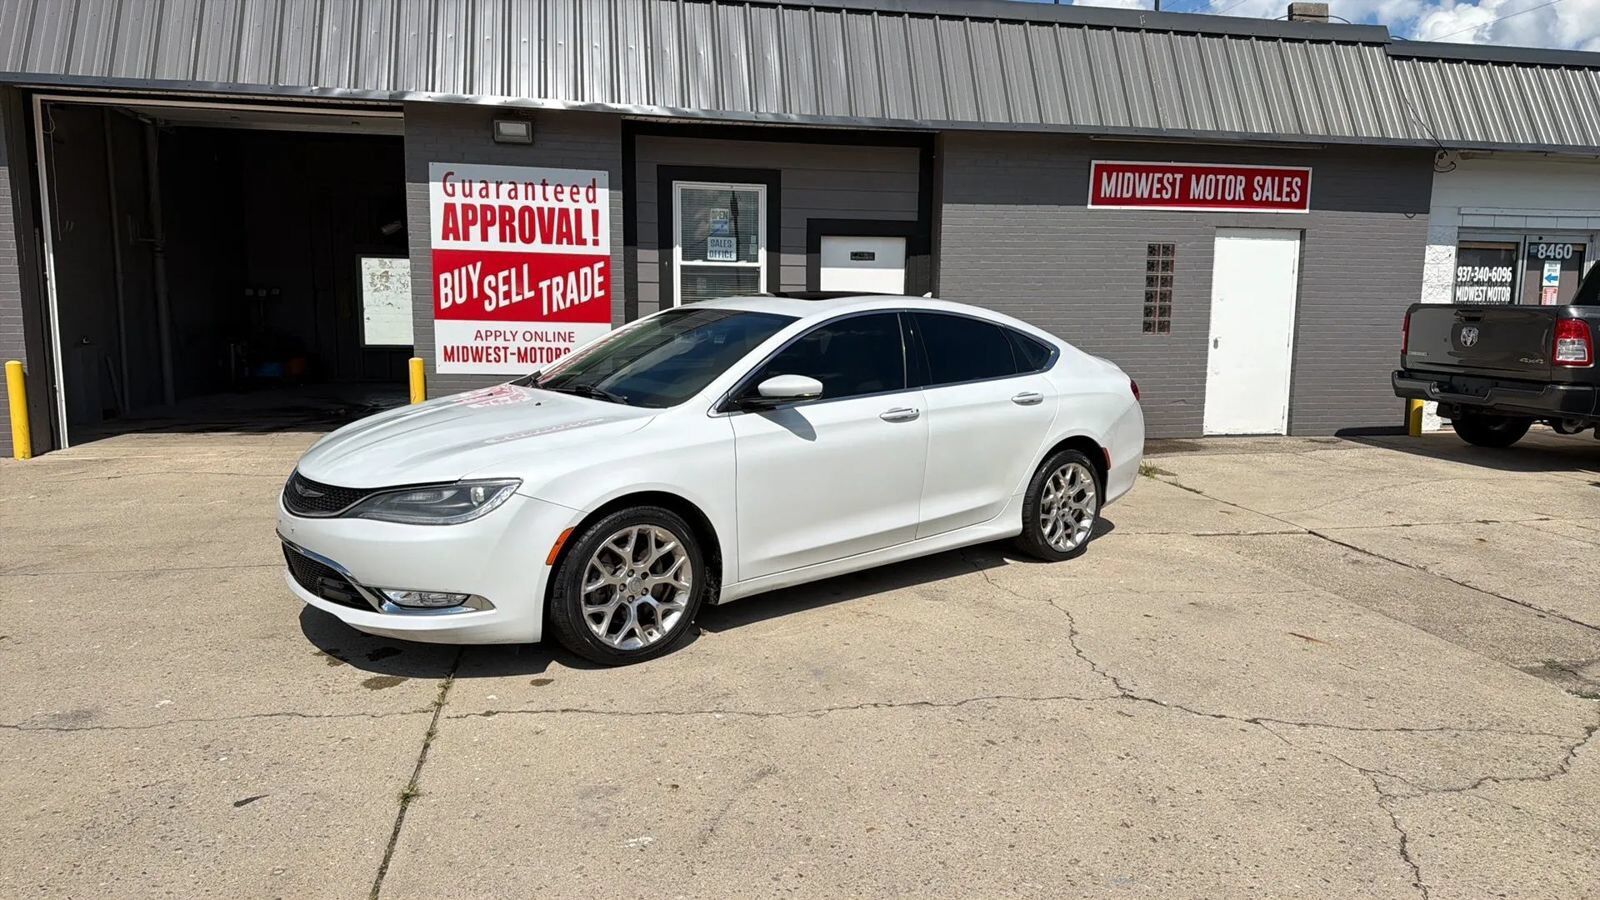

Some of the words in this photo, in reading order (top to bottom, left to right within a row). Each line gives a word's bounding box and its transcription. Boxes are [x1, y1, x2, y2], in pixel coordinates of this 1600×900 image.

[442, 171, 597, 204] Guaranteed
[1101, 171, 1183, 199] MIDWEST
[1190, 174, 1246, 200] MOTOR
[1252, 176, 1302, 202] SALES
[441, 202, 600, 246] APPROVAL!
[710, 239, 732, 248] SALES
[1538, 243, 1572, 259] 8460
[709, 250, 734, 259] OFFICE
[1457, 266, 1512, 282] 937-340-6096
[439, 261, 482, 310] BUY
[483, 263, 535, 312] SELL
[539, 261, 605, 316] TRADE
[1456, 286, 1487, 301] MIDWEST
[1487, 286, 1511, 301] MOTOR
[474, 329, 518, 342] APPLY
[522, 330, 575, 343] ONLINE
